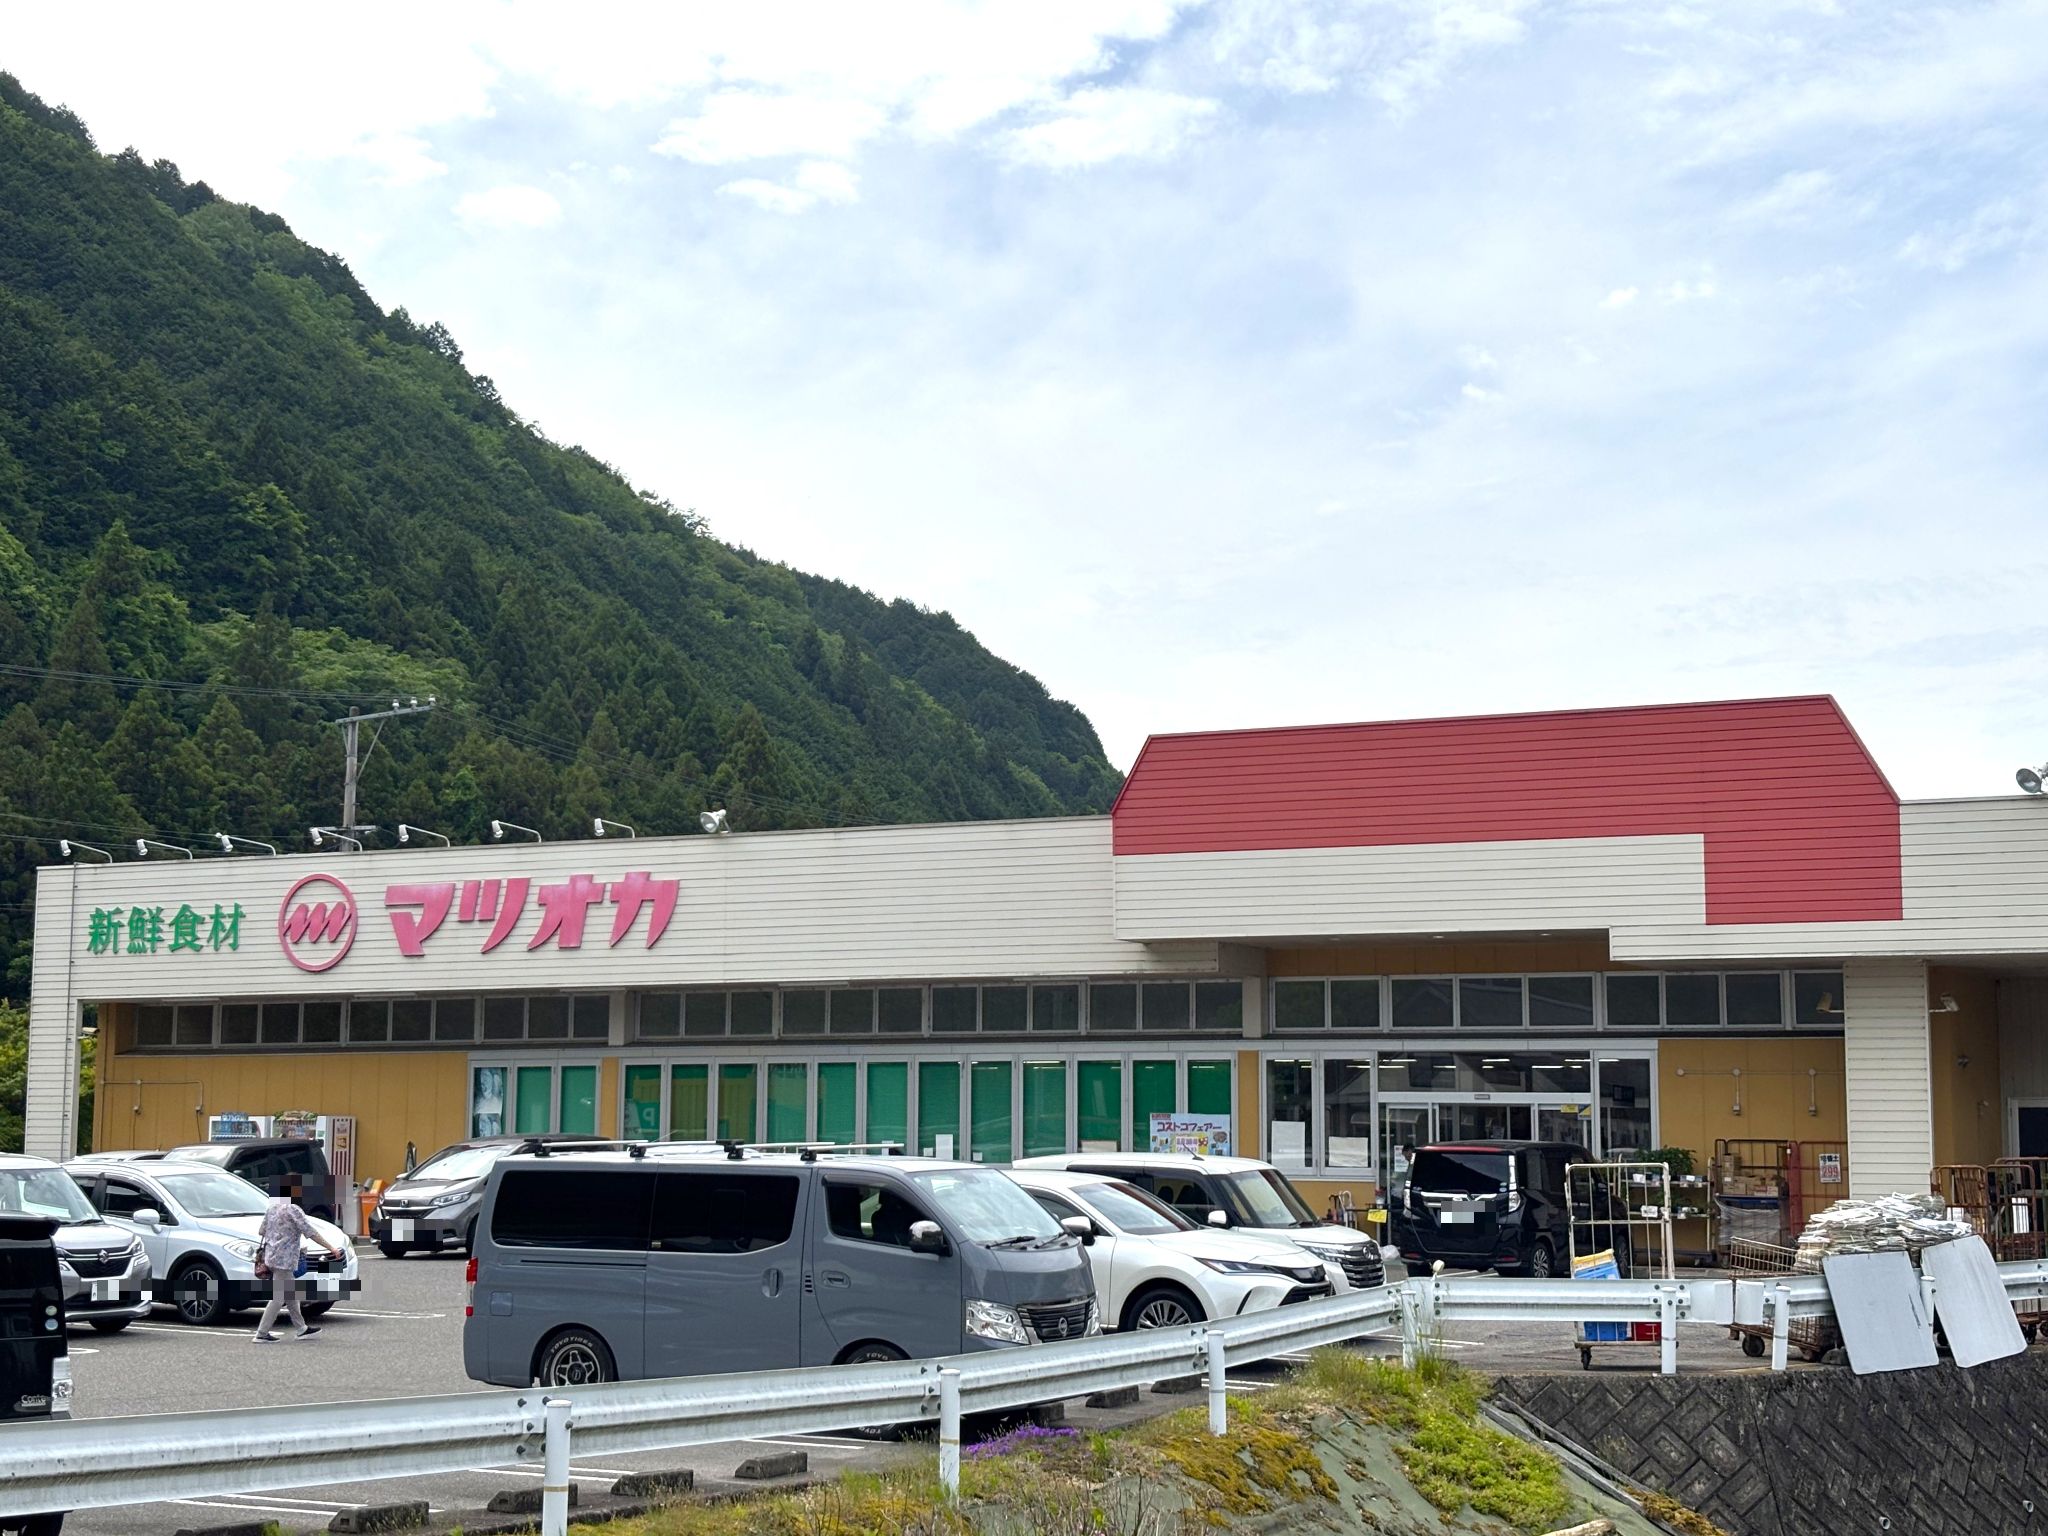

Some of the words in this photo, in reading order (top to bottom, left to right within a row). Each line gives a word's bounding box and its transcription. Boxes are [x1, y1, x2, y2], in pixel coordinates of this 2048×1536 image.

[87, 902, 247, 956] 新鮮食材
[384, 870, 681, 957] マツオカ
[1157, 1121, 1223, 1133] コストコフェアー
